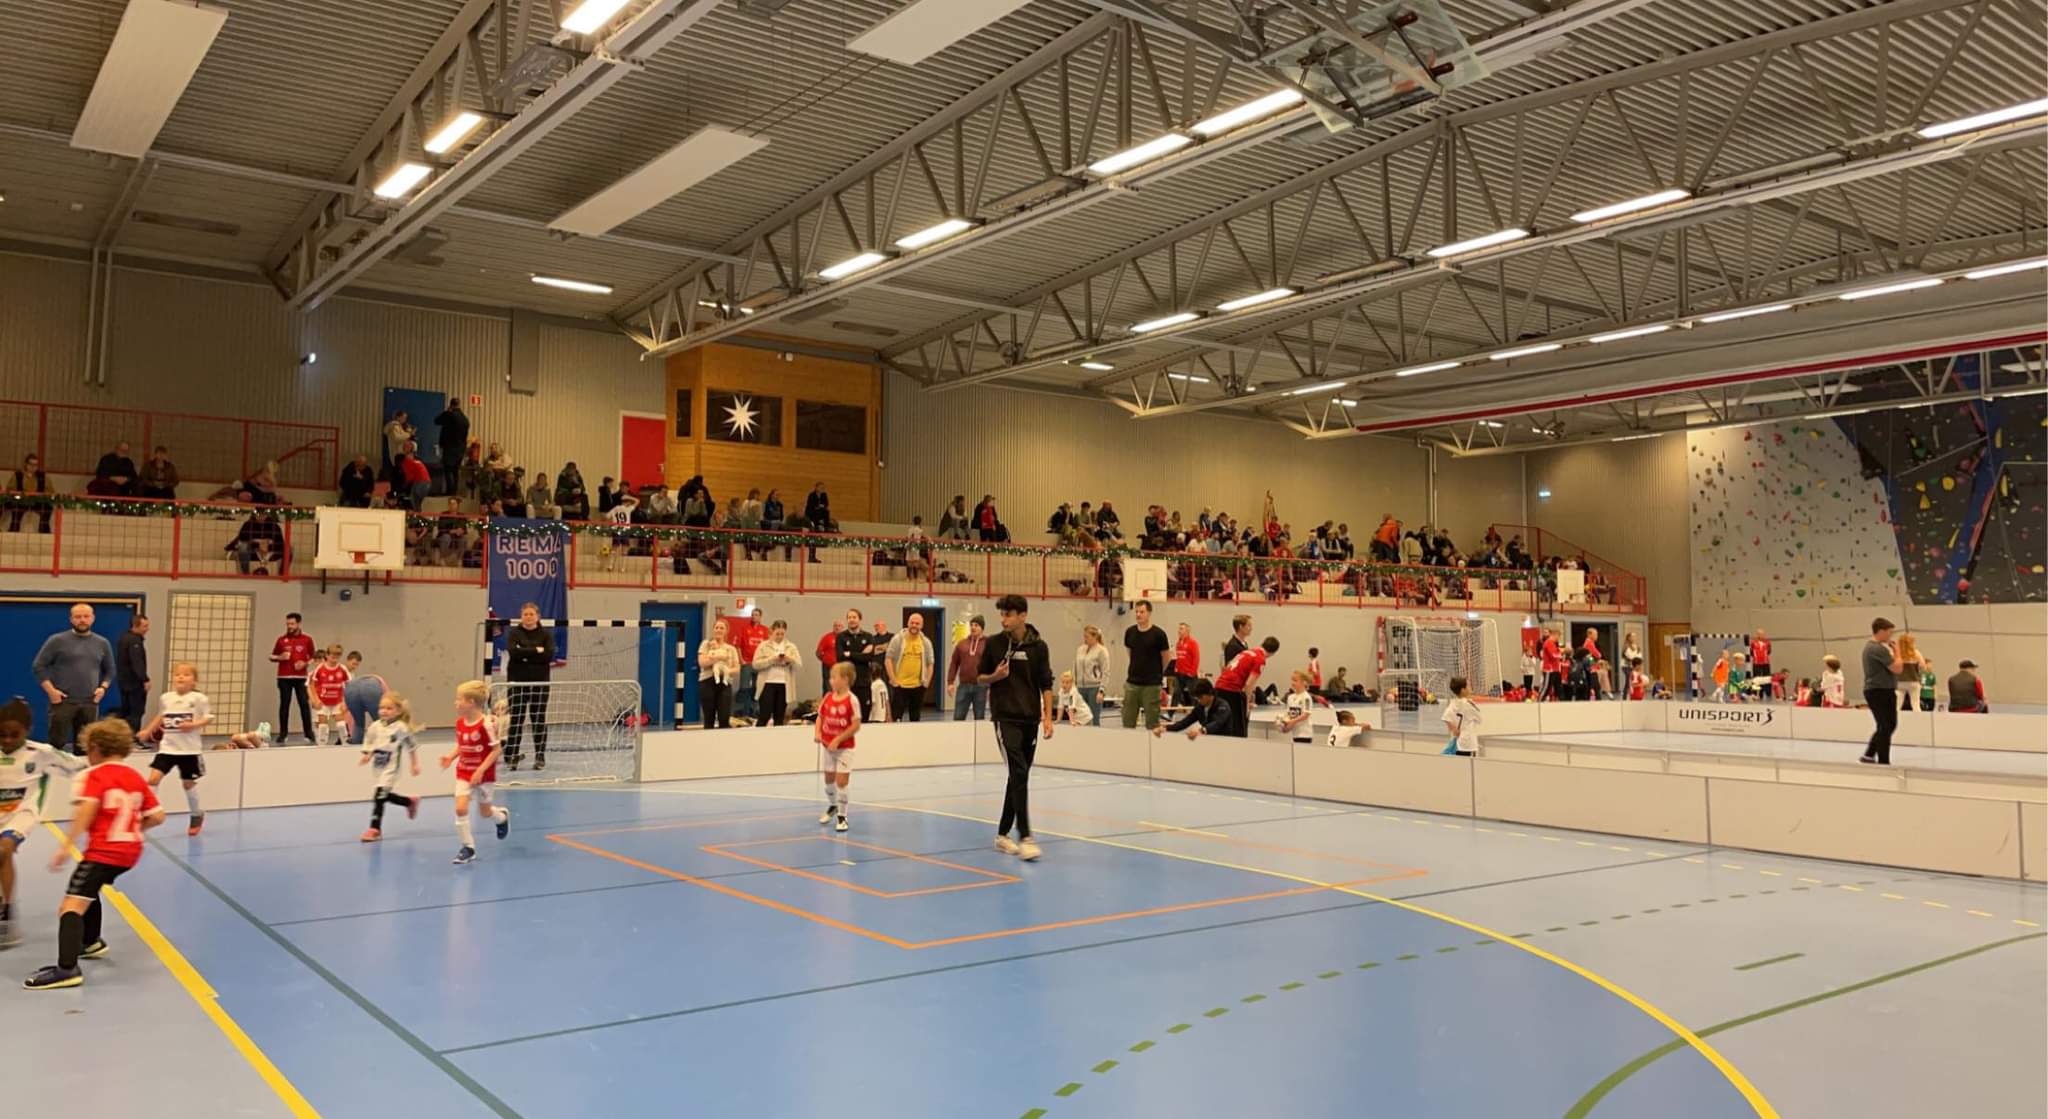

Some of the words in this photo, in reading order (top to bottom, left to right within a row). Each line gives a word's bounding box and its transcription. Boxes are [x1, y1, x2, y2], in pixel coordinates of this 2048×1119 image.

[496, 534, 562, 555] REMA
[505, 557, 558, 579] 1000
[1679, 708, 1763, 722] UNISPORT
